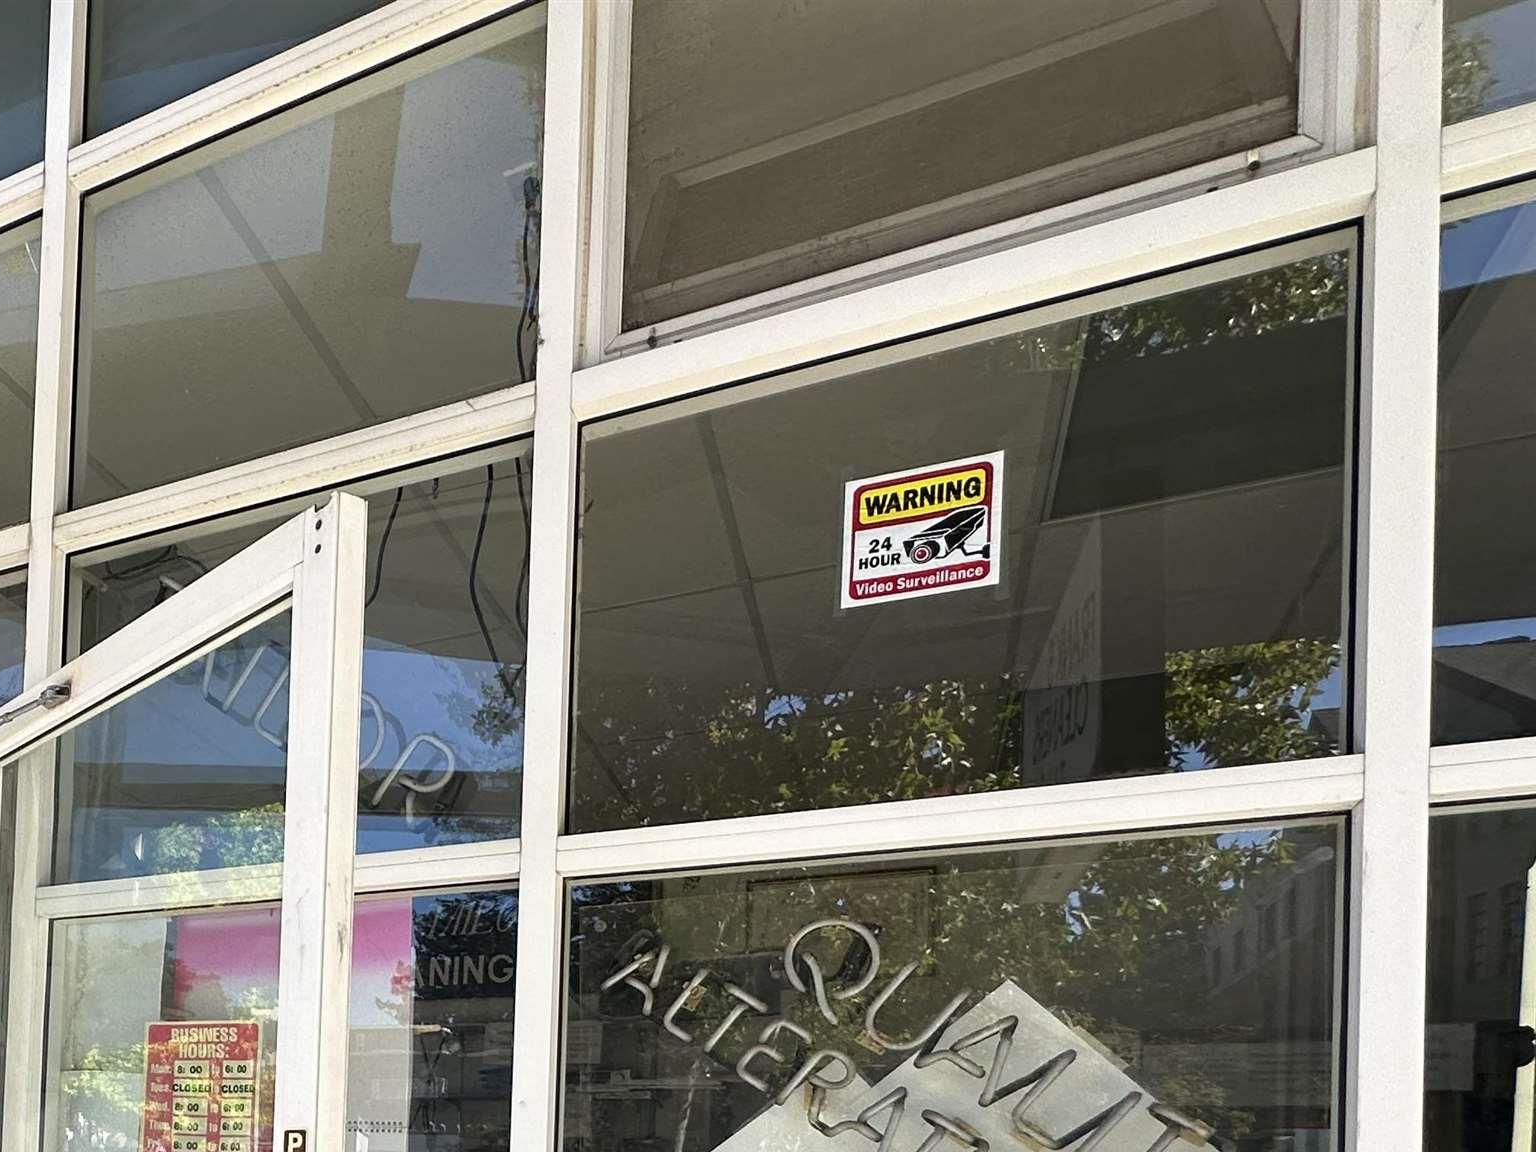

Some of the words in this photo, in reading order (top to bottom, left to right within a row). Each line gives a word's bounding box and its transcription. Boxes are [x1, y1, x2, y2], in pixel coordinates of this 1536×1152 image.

[865, 476, 981, 517] WARNING
[868, 536, 892, 554] 24
[858, 553, 901, 569] HOUR
[856, 581, 893, 596] Video
[897, 566, 984, 590] Surveillance
[170, 1026, 238, 1043] BUSINESS
[179, 1042, 229, 1059] HOURS:
[173, 1084, 211, 1093] CLOSED
[221, 1085, 255, 1093] CLOSED
